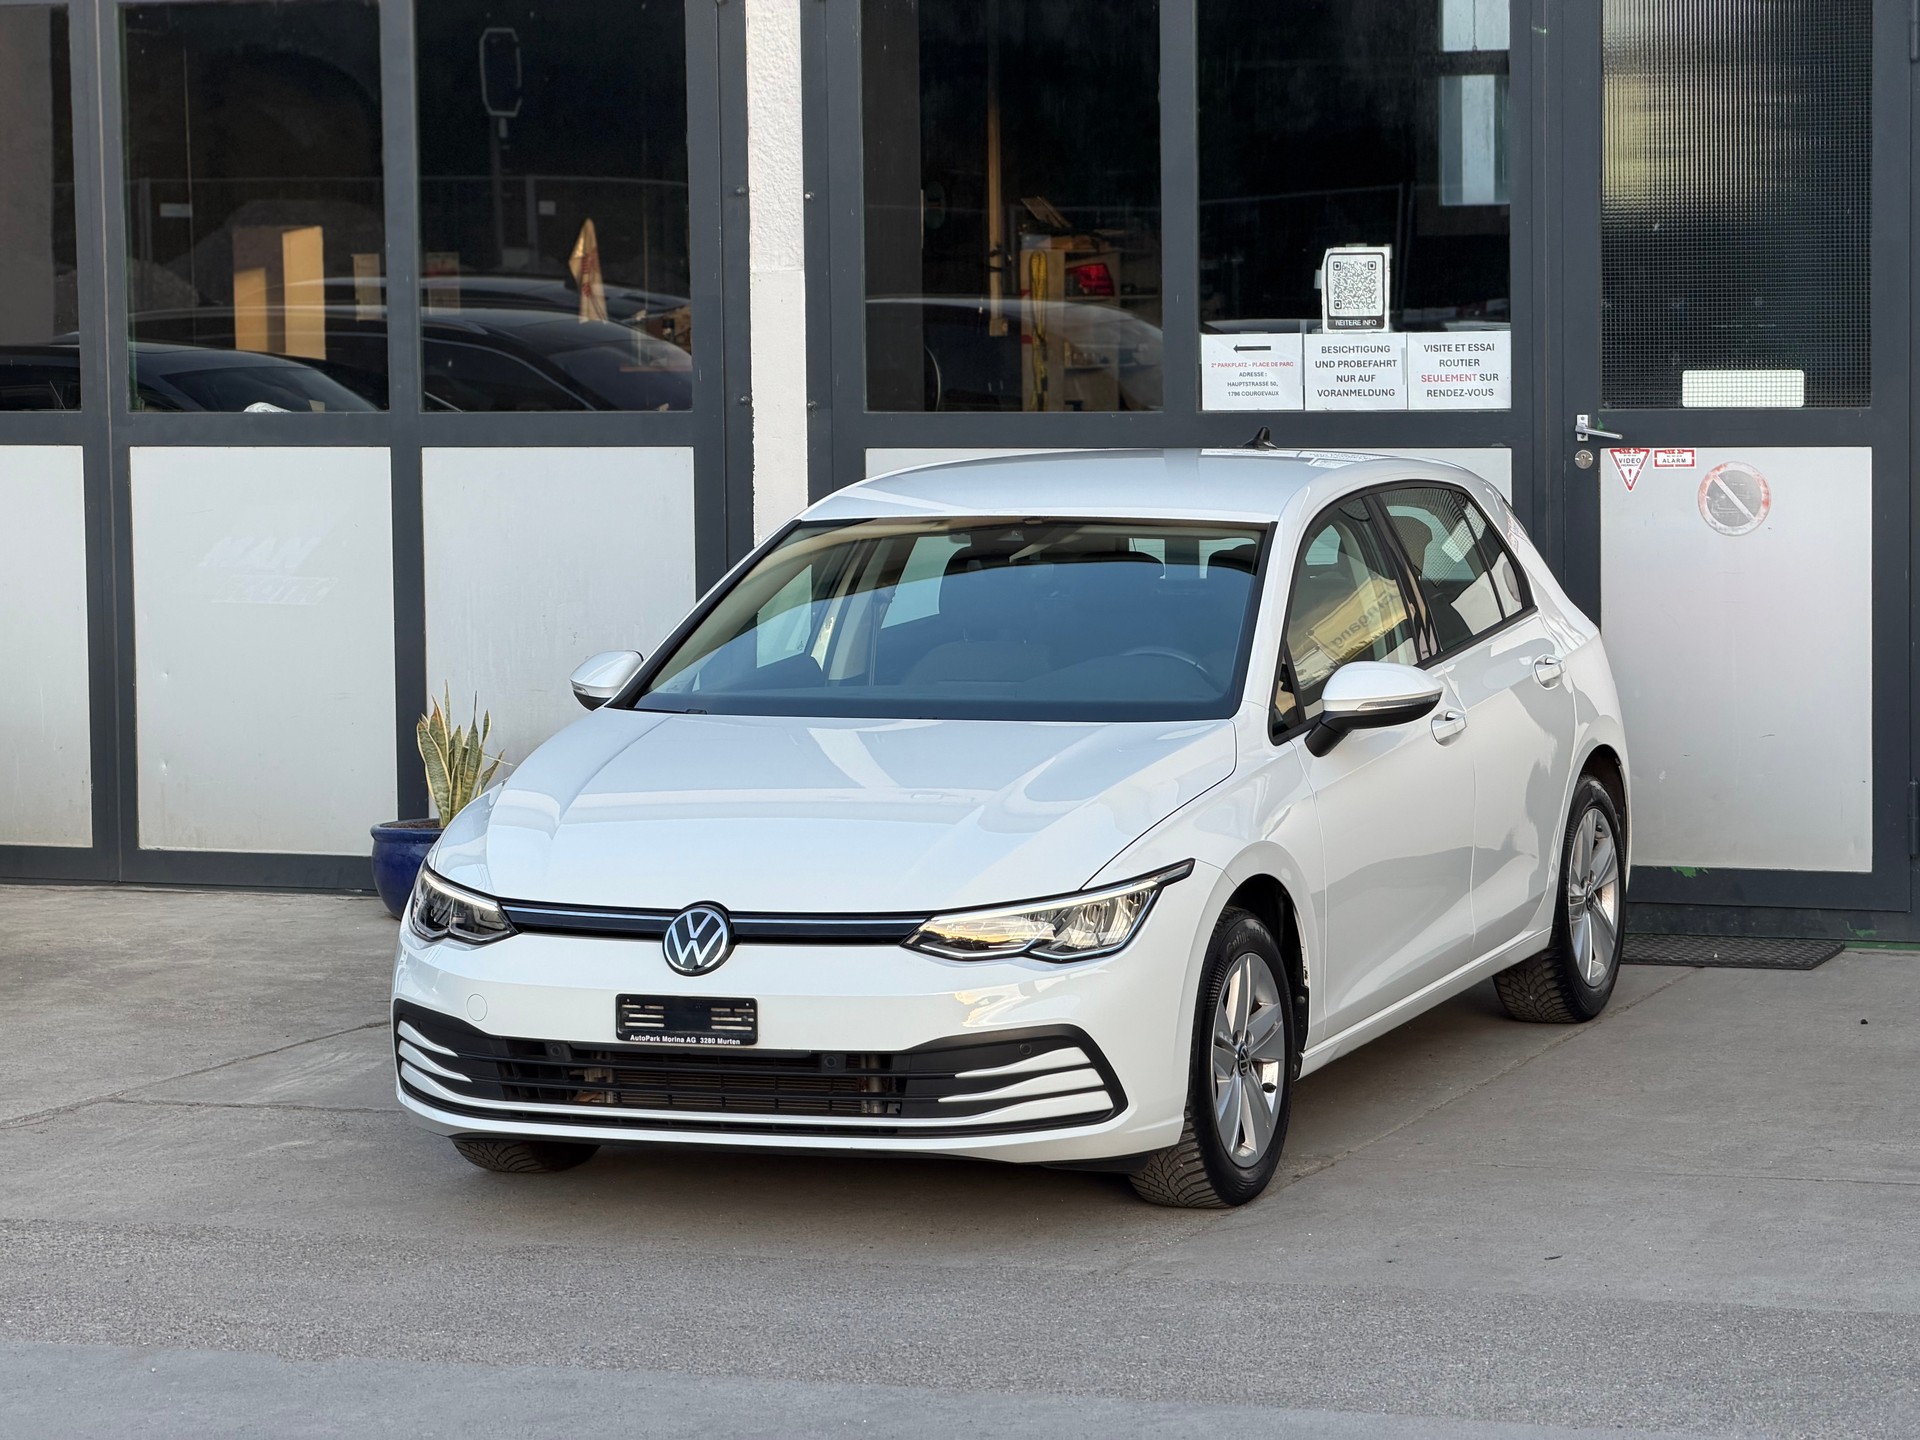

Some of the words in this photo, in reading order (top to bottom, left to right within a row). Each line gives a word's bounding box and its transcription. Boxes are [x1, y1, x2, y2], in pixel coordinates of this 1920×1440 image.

[1321, 345, 1391, 354] BESICHTIGUNG
[1423, 343, 1453, 353] VISITE
[1454, 343, 1466, 352] ET
[1467, 343, 1495, 352] ESSAI
[1315, 359, 1335, 369] UND
[1337, 359, 1397, 368] PROBEFAHRT
[1438, 358, 1481, 367] ROUTIER
[1336, 374, 1356, 383] NUR
[1357, 374, 1376, 382] AUF
[1421, 373, 1477, 382] SEULEMENT
[1478, 373, 1499, 382] SUR
[1317, 388, 1396, 398] VORANMELDUNG
[1426, 388, 1494, 397] RENDEZ-VOUS
[630, 1034, 661, 1042] AutoPark
[686, 1036, 697, 1044] AG
[717, 1037, 741, 1045] Murten
